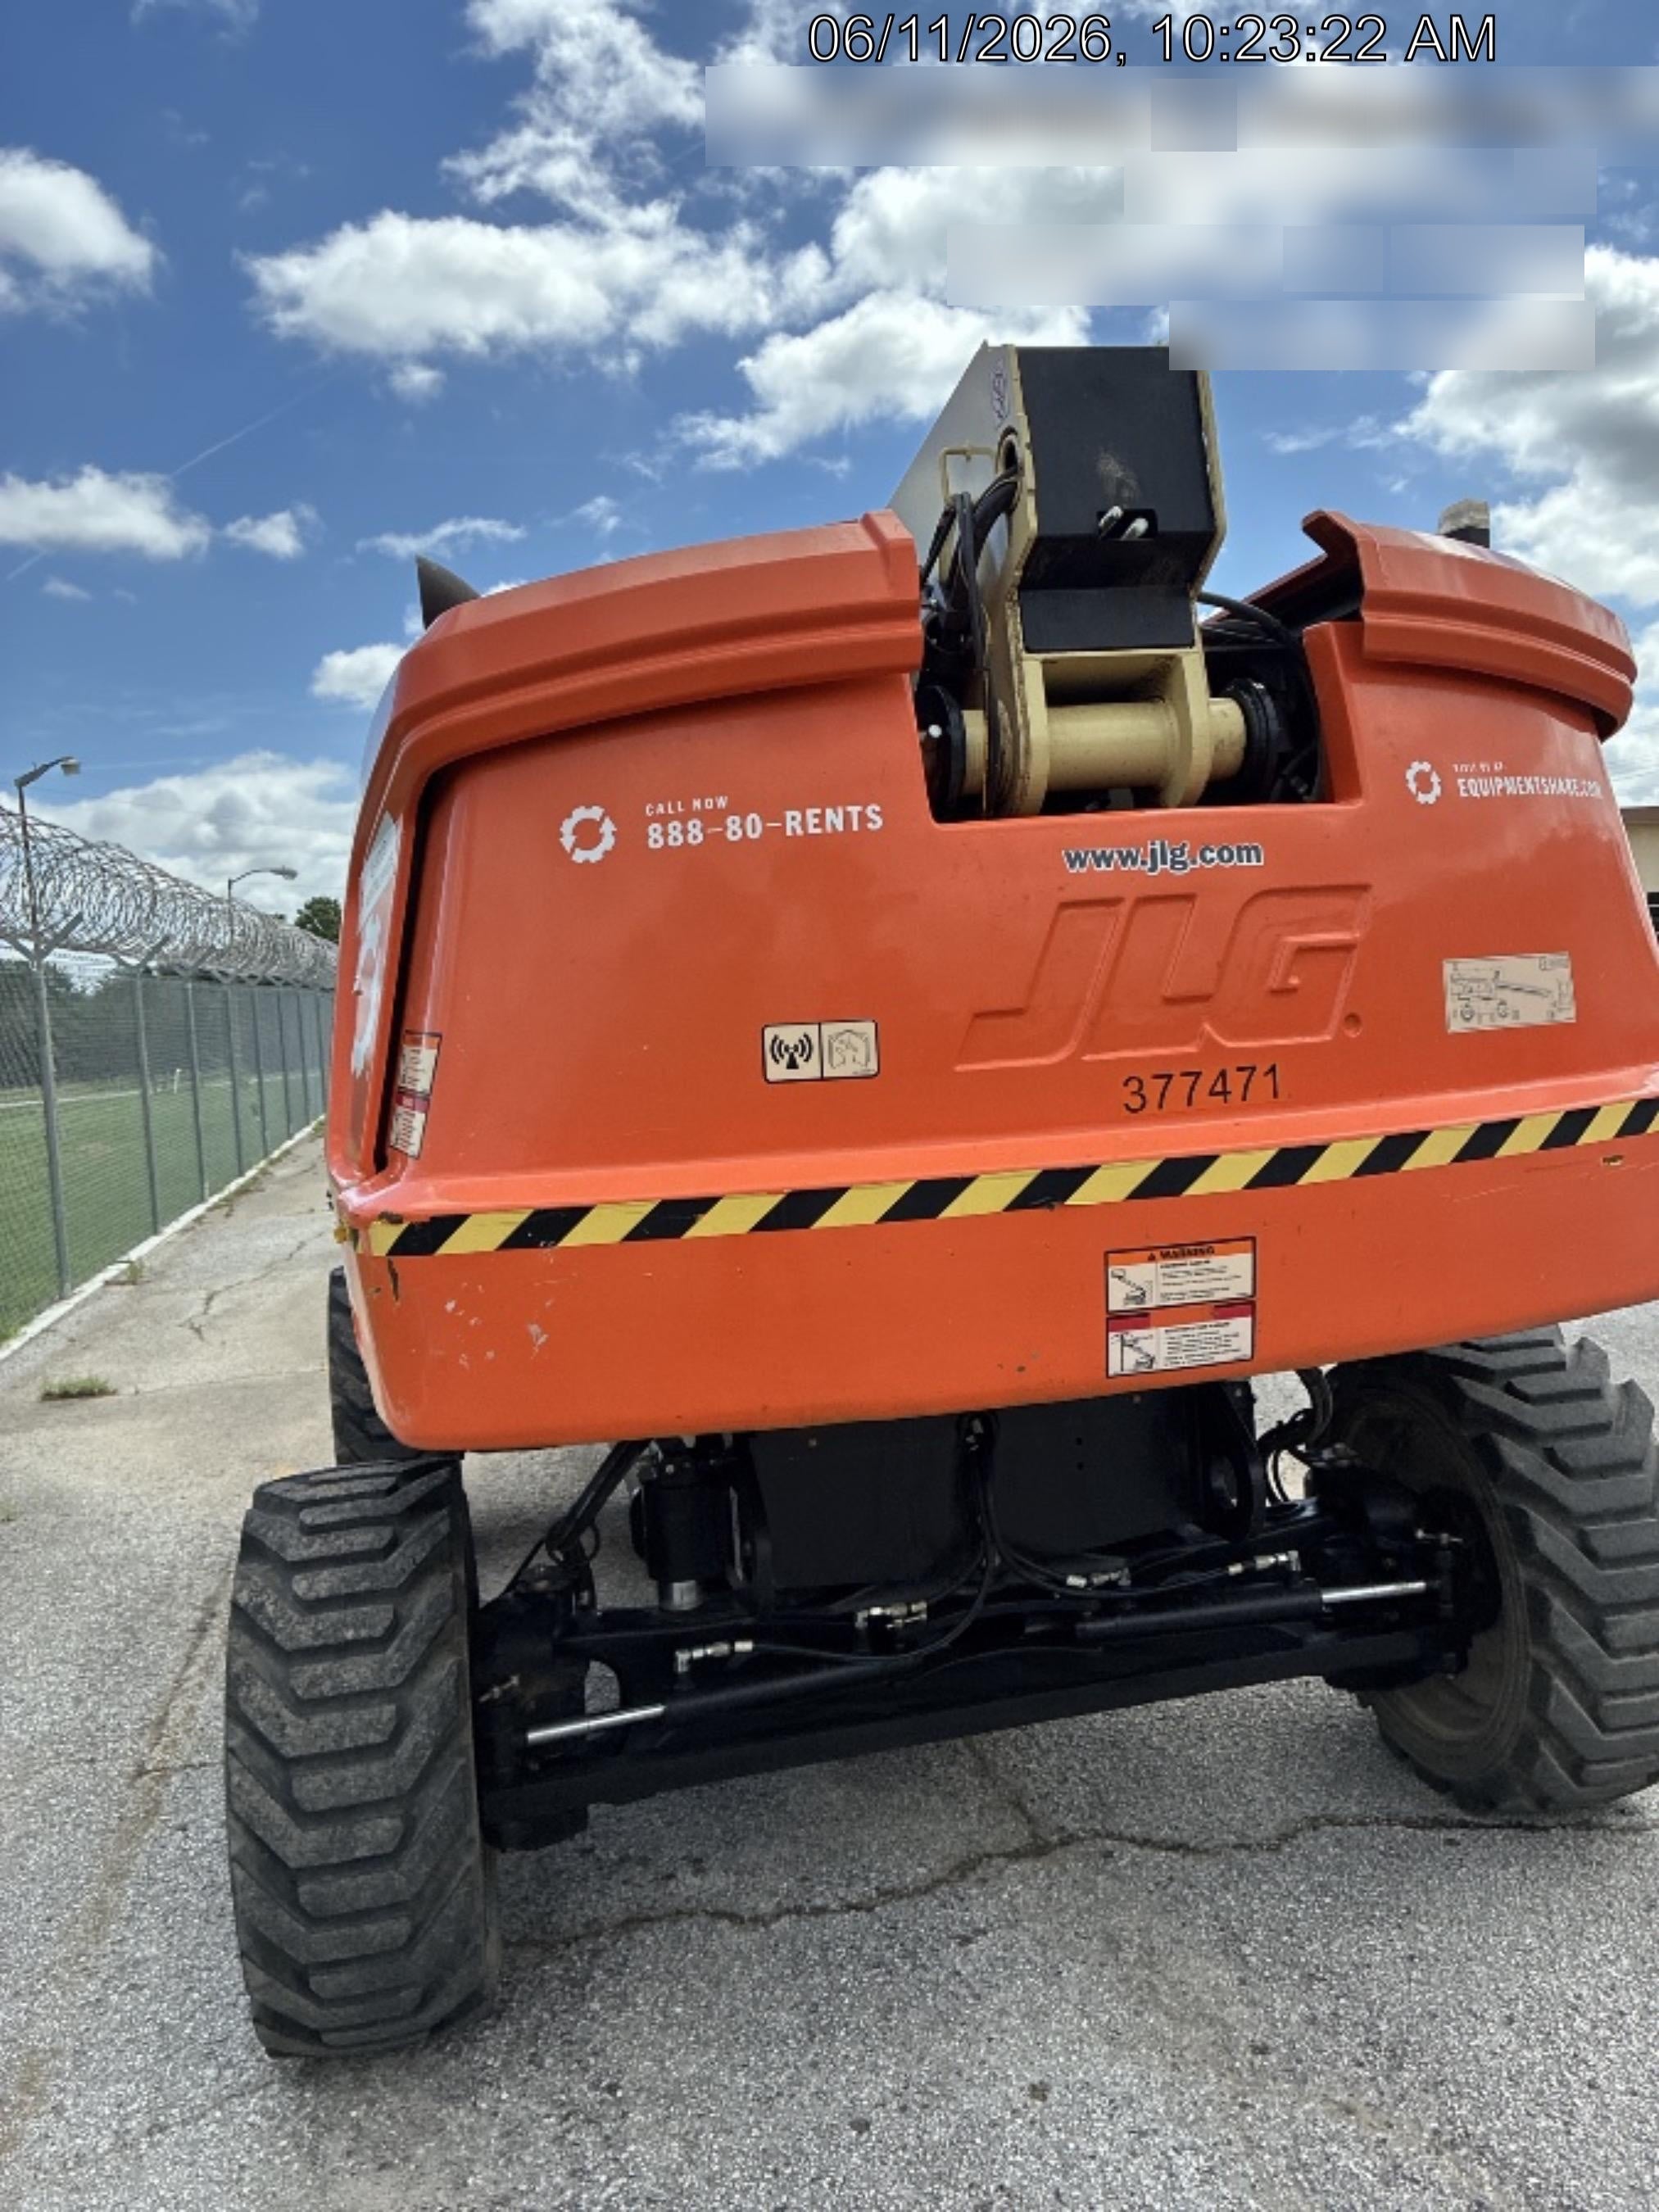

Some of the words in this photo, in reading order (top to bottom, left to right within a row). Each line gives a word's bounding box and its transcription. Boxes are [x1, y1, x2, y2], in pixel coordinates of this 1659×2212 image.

[646, 800, 685, 817] CALL
[692, 796, 728, 811] NOW
[647, 804, 884, 850] 888-80-RENTS
[1063, 841, 1264, 875] www.jlg.com
[954, 883, 1373, 1072] JLG
[1122, 1063, 1280, 1114] 377471
